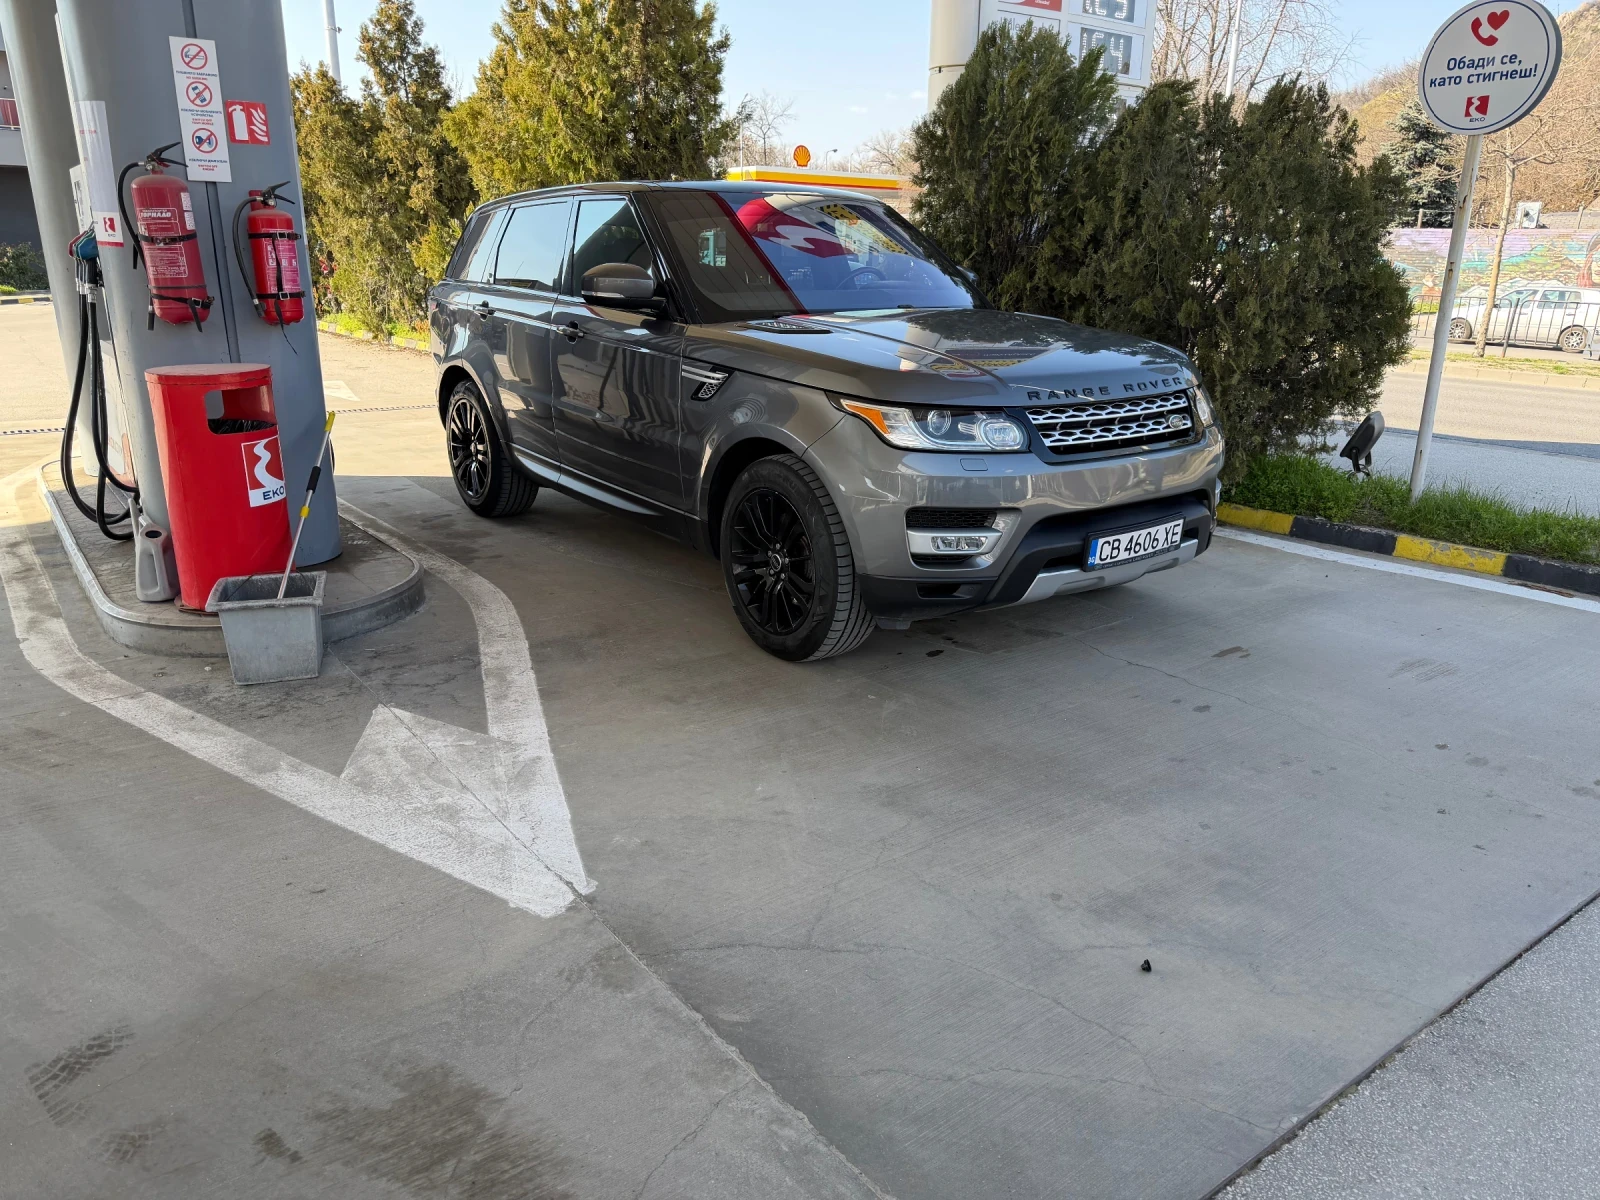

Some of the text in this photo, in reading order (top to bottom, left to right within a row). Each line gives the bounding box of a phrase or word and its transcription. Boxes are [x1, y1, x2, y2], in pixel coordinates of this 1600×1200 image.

[1447, 53, 1522, 71] Обади се,
[1429, 63, 1538, 88] като стигнеш!
[1027, 376, 1183, 401] RANGE ROVER
[262, 485, 285, 501] EKO
[1099, 523, 1181, 562] CB 4606 XE
